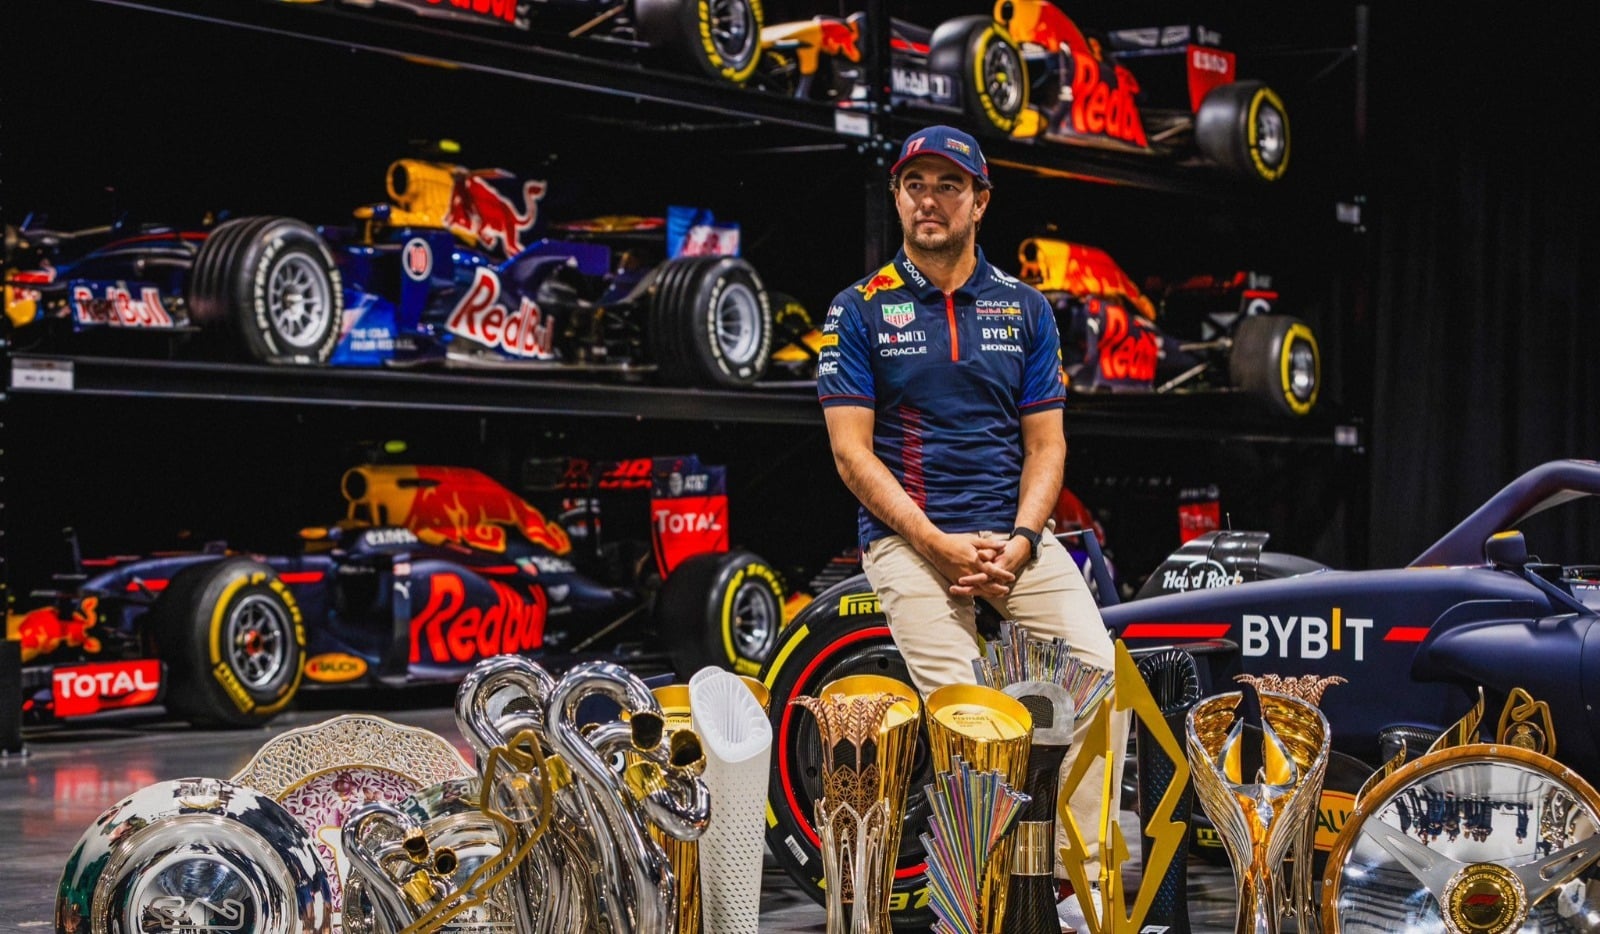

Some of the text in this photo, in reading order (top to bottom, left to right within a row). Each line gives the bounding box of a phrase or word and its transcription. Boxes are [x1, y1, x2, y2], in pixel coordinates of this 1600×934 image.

[884, 304, 912, 315] TAG
[975, 299, 1020, 308] ORACLE
[878, 331, 912, 344] Mobil
[981, 325, 1020, 340] BYBIT
[880, 346, 928, 357] ORACLE
[981, 343, 1023, 353] HONDA
[655, 510, 722, 534] TOTAL
[1242, 607, 1375, 662] BYBIT
[56, 669, 158, 699] TOTAL
[1466, 873, 1506, 888] AUSTRALIAN
